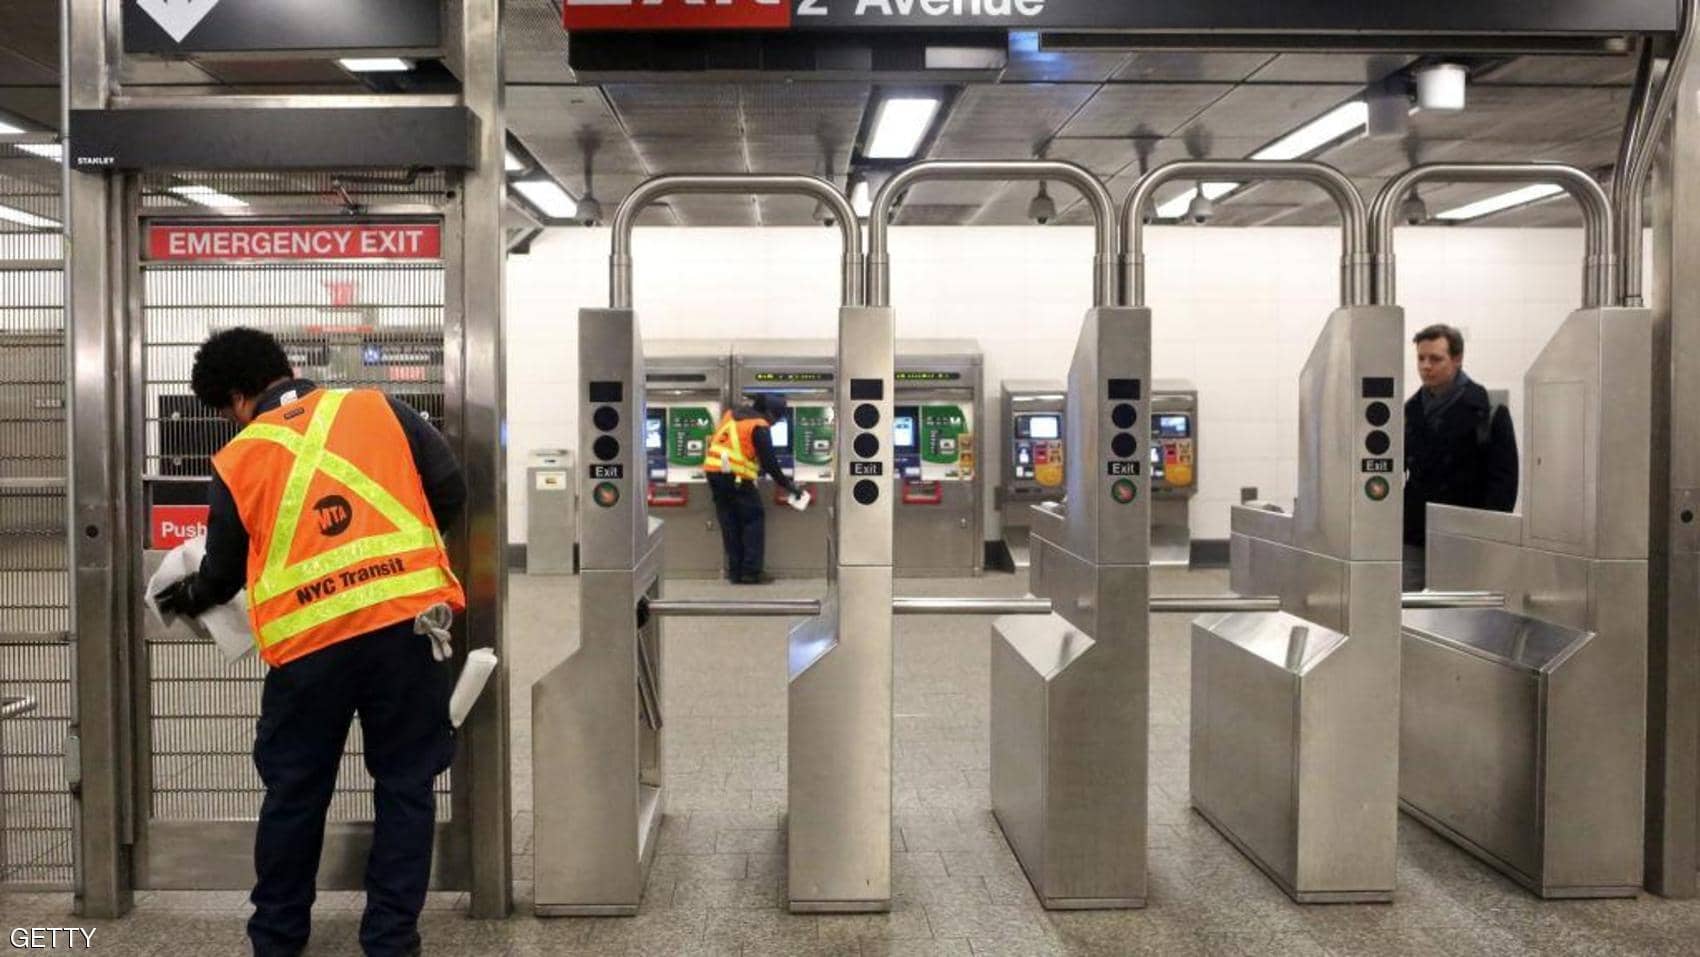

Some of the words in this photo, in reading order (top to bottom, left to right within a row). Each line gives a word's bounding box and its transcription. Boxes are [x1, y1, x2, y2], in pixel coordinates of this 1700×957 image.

[169, 231, 352, 255] EMERGENCY
[360, 230, 423, 254] EXIT
[855, 463, 878, 475] Exit
[1112, 463, 1134, 475] Exit
[1366, 459, 1388, 471] Exit
[595, 466, 618, 477] Exit
[162, 521, 208, 538] Push
[296, 578, 336, 605] NYC
[339, 557, 405, 588] Transit
